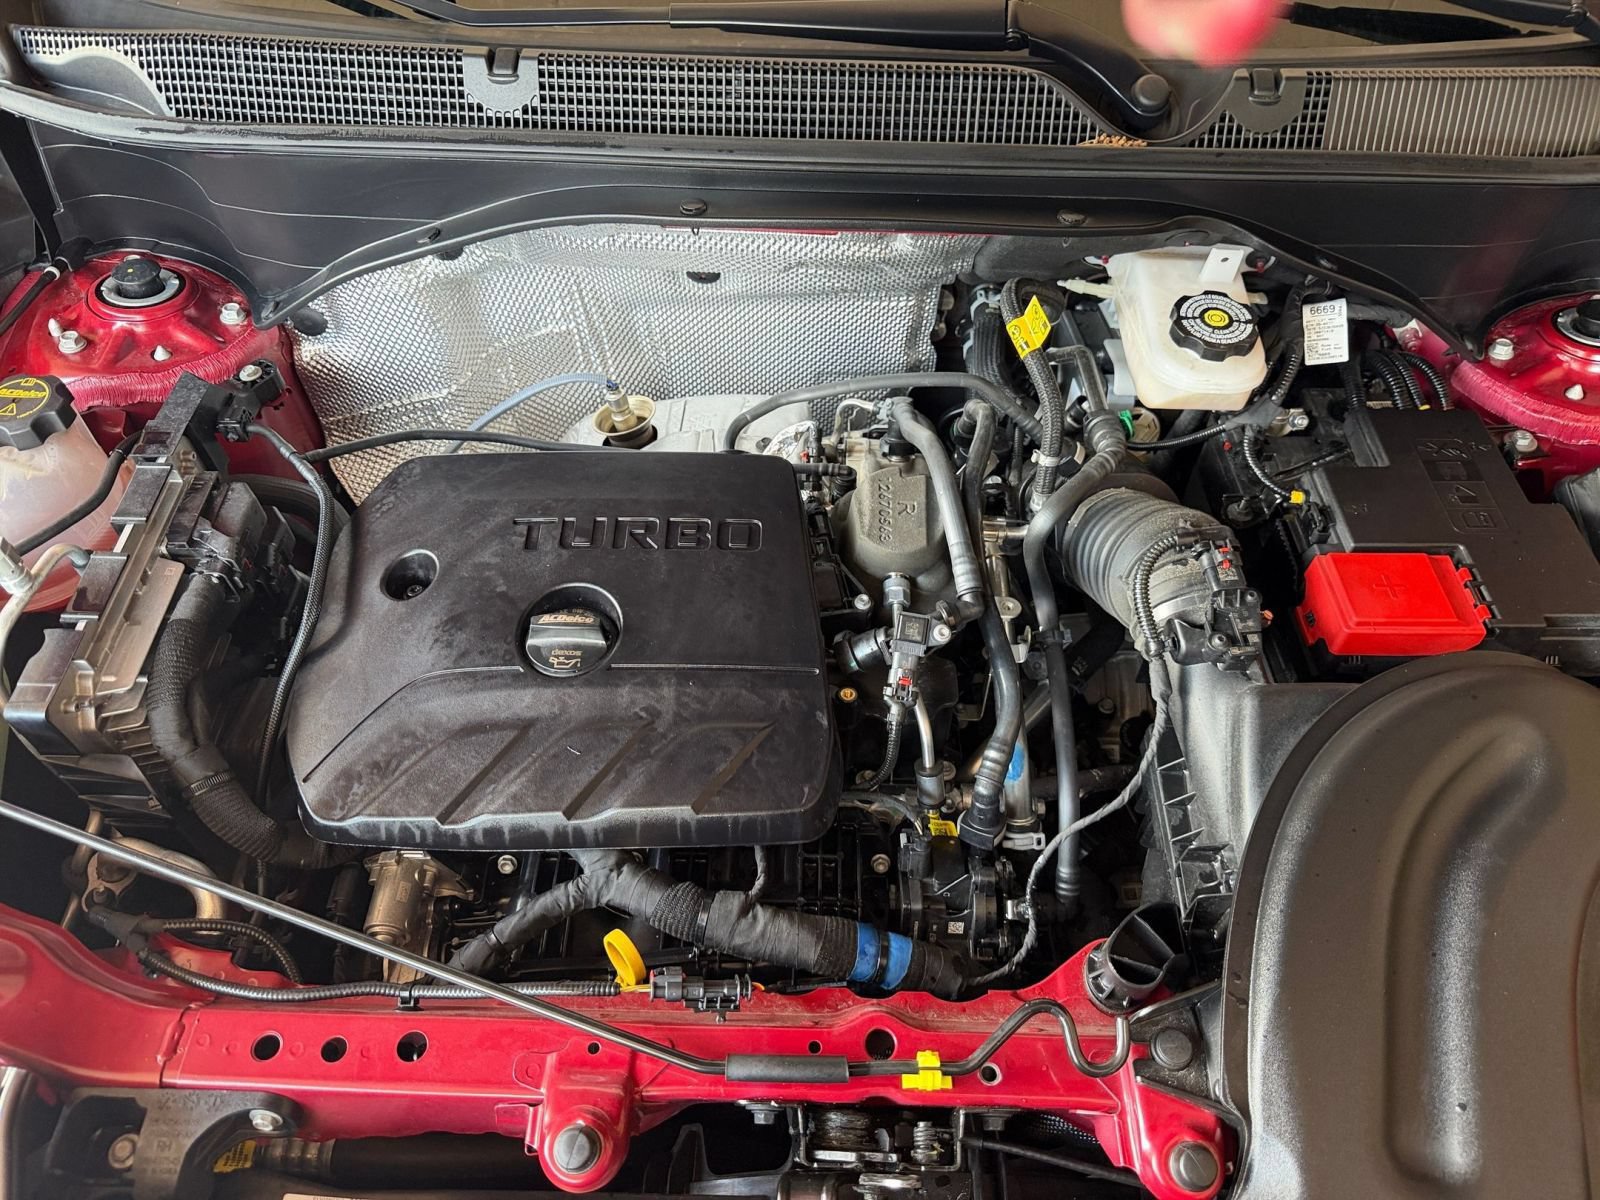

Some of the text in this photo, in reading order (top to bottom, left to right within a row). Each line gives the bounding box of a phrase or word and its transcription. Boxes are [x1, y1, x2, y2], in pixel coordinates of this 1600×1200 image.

[1310, 304, 1336, 316] 6669
[897, 500, 917, 516] R
[513, 516, 763, 551] TURBO
[537, 614, 595, 625] ACDelco
